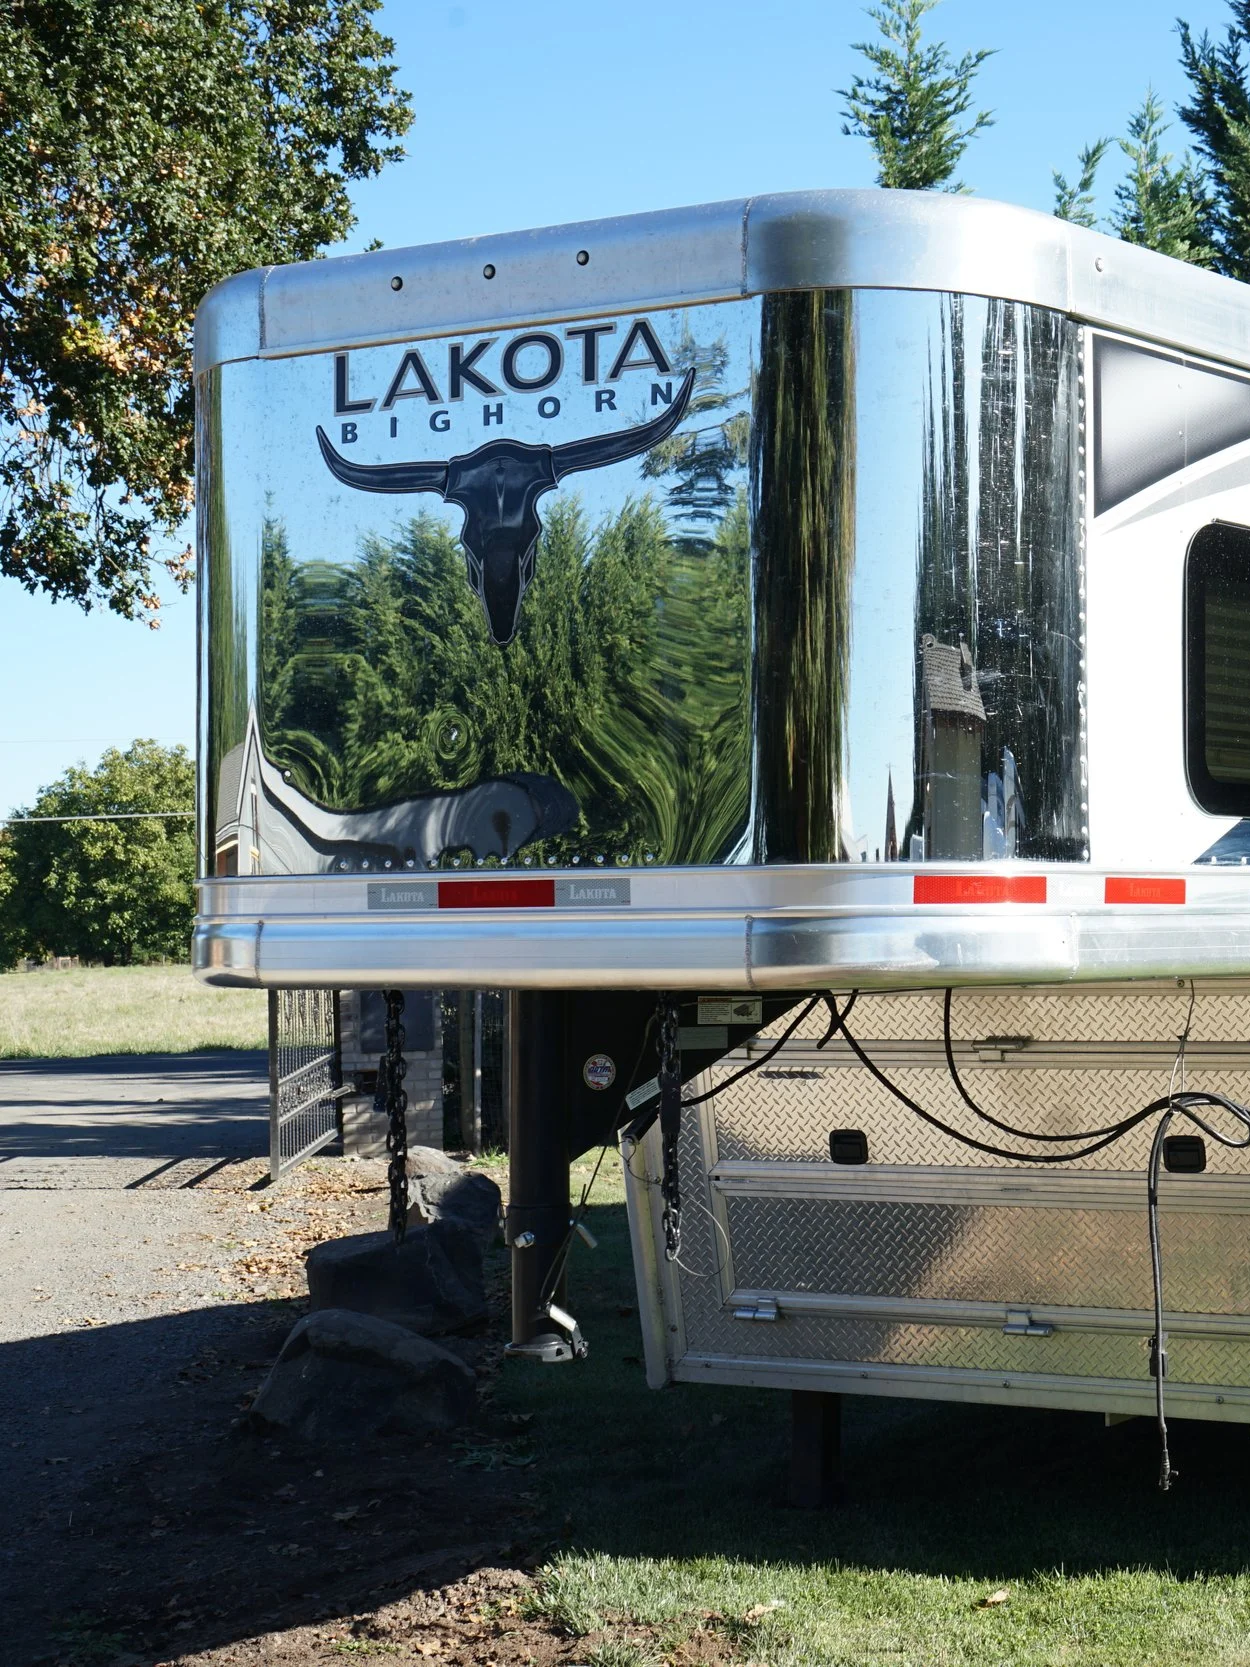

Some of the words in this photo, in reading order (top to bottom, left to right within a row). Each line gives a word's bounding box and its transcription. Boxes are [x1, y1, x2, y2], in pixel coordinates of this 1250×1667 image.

[334, 318, 676, 417] LAKOTA
[341, 382, 673, 444] BIGHORN
[381, 888, 425, 903] LAKOTA
[569, 884, 617, 900] LAKOTA
